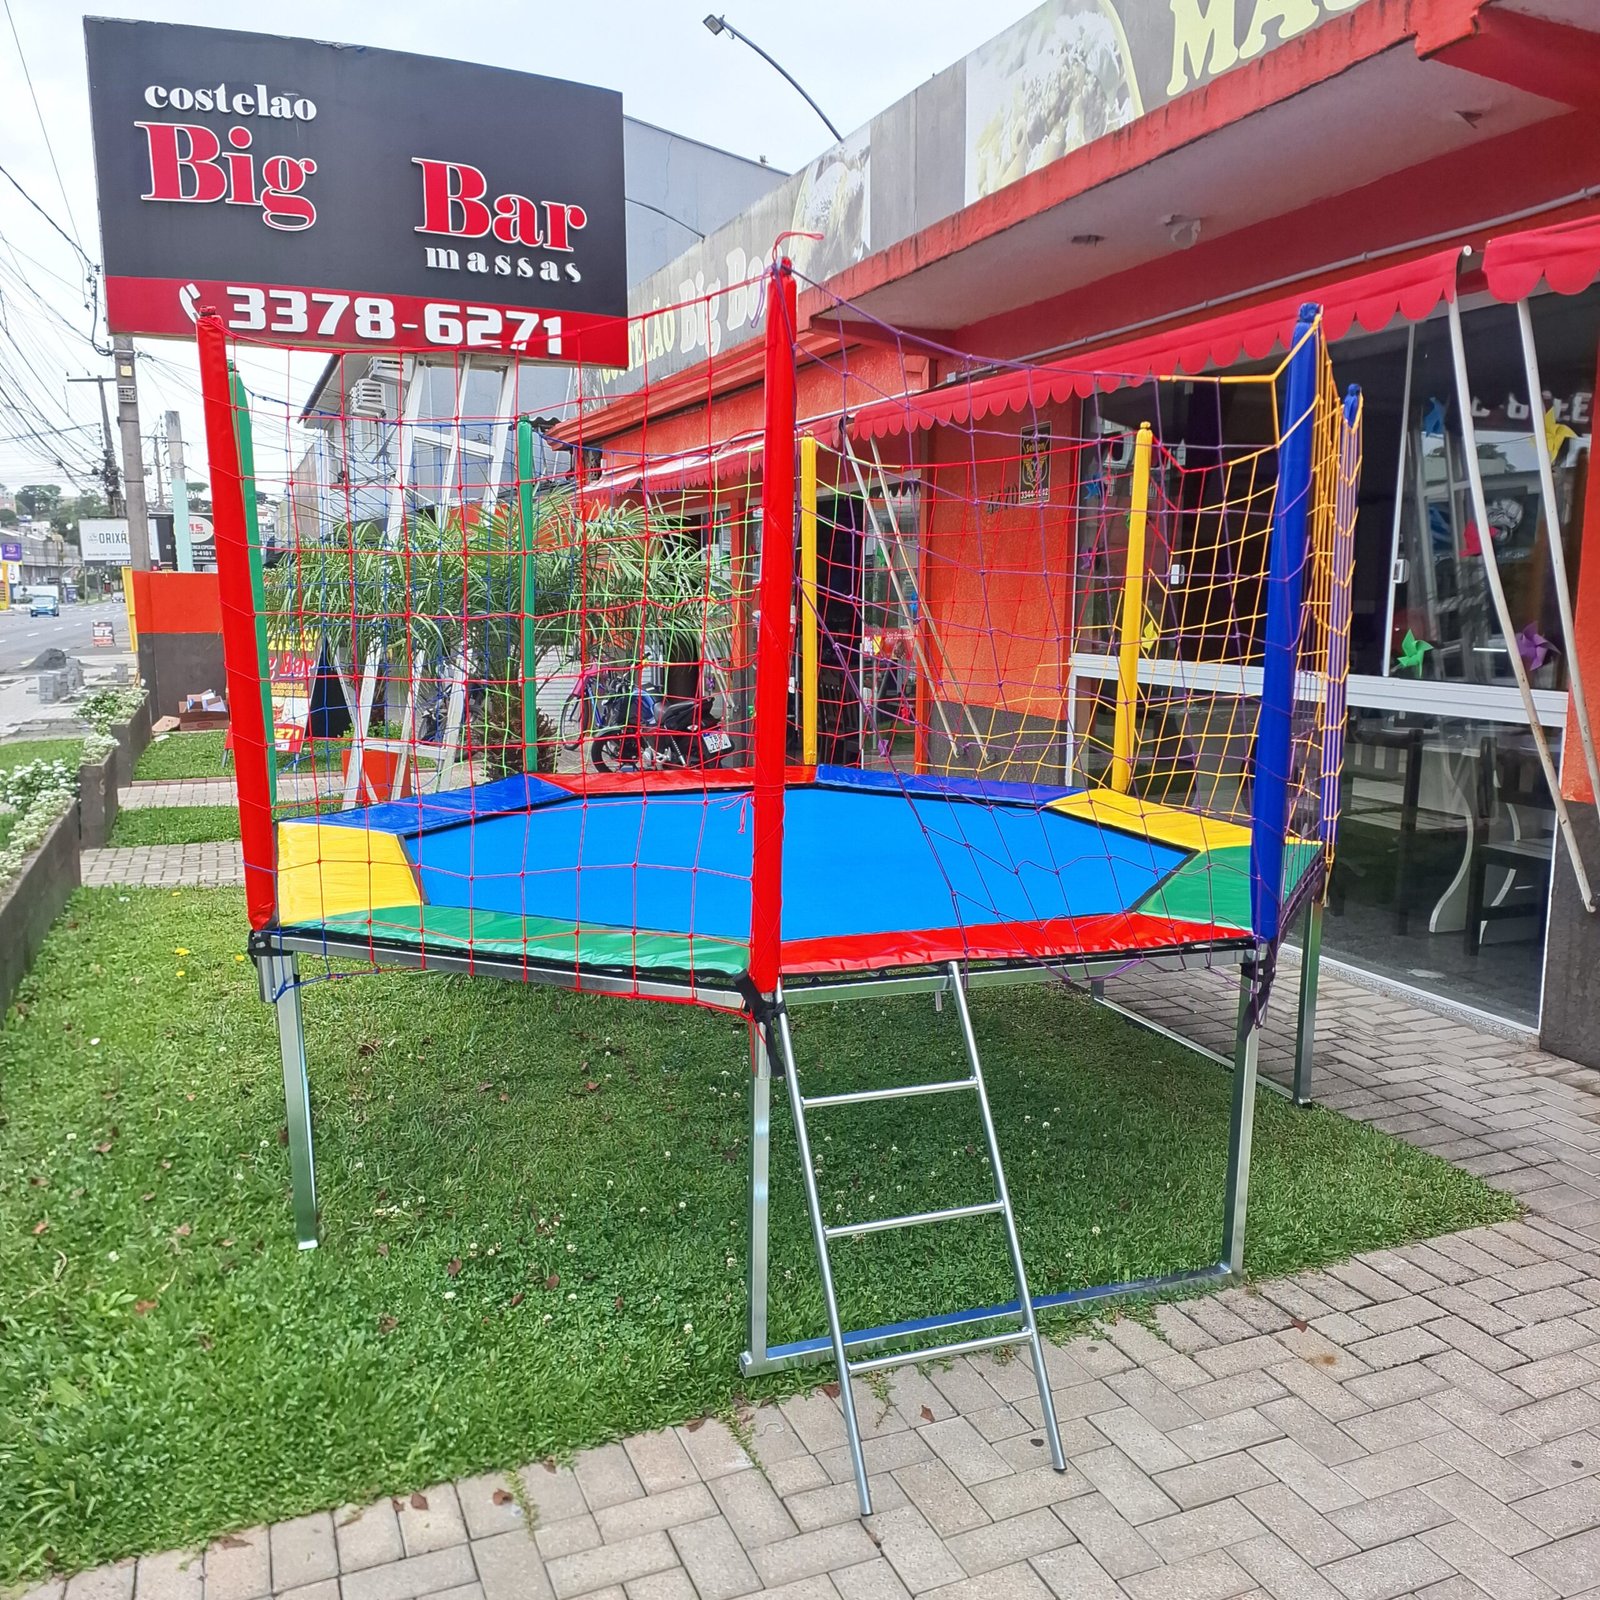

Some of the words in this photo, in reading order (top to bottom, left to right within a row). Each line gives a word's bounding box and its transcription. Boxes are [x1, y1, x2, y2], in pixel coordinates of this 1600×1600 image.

[1166, 0, 1364, 96] MA
[144, 82, 318, 121] costelao
[133, 120, 318, 231] Big
[411, 157, 588, 252] Bar
[424, 246, 582, 283] massas
[225, 286, 562, 355] 3378-6271
[602, 297, 676, 385] TELÃO
[679, 269, 722, 358] Big
